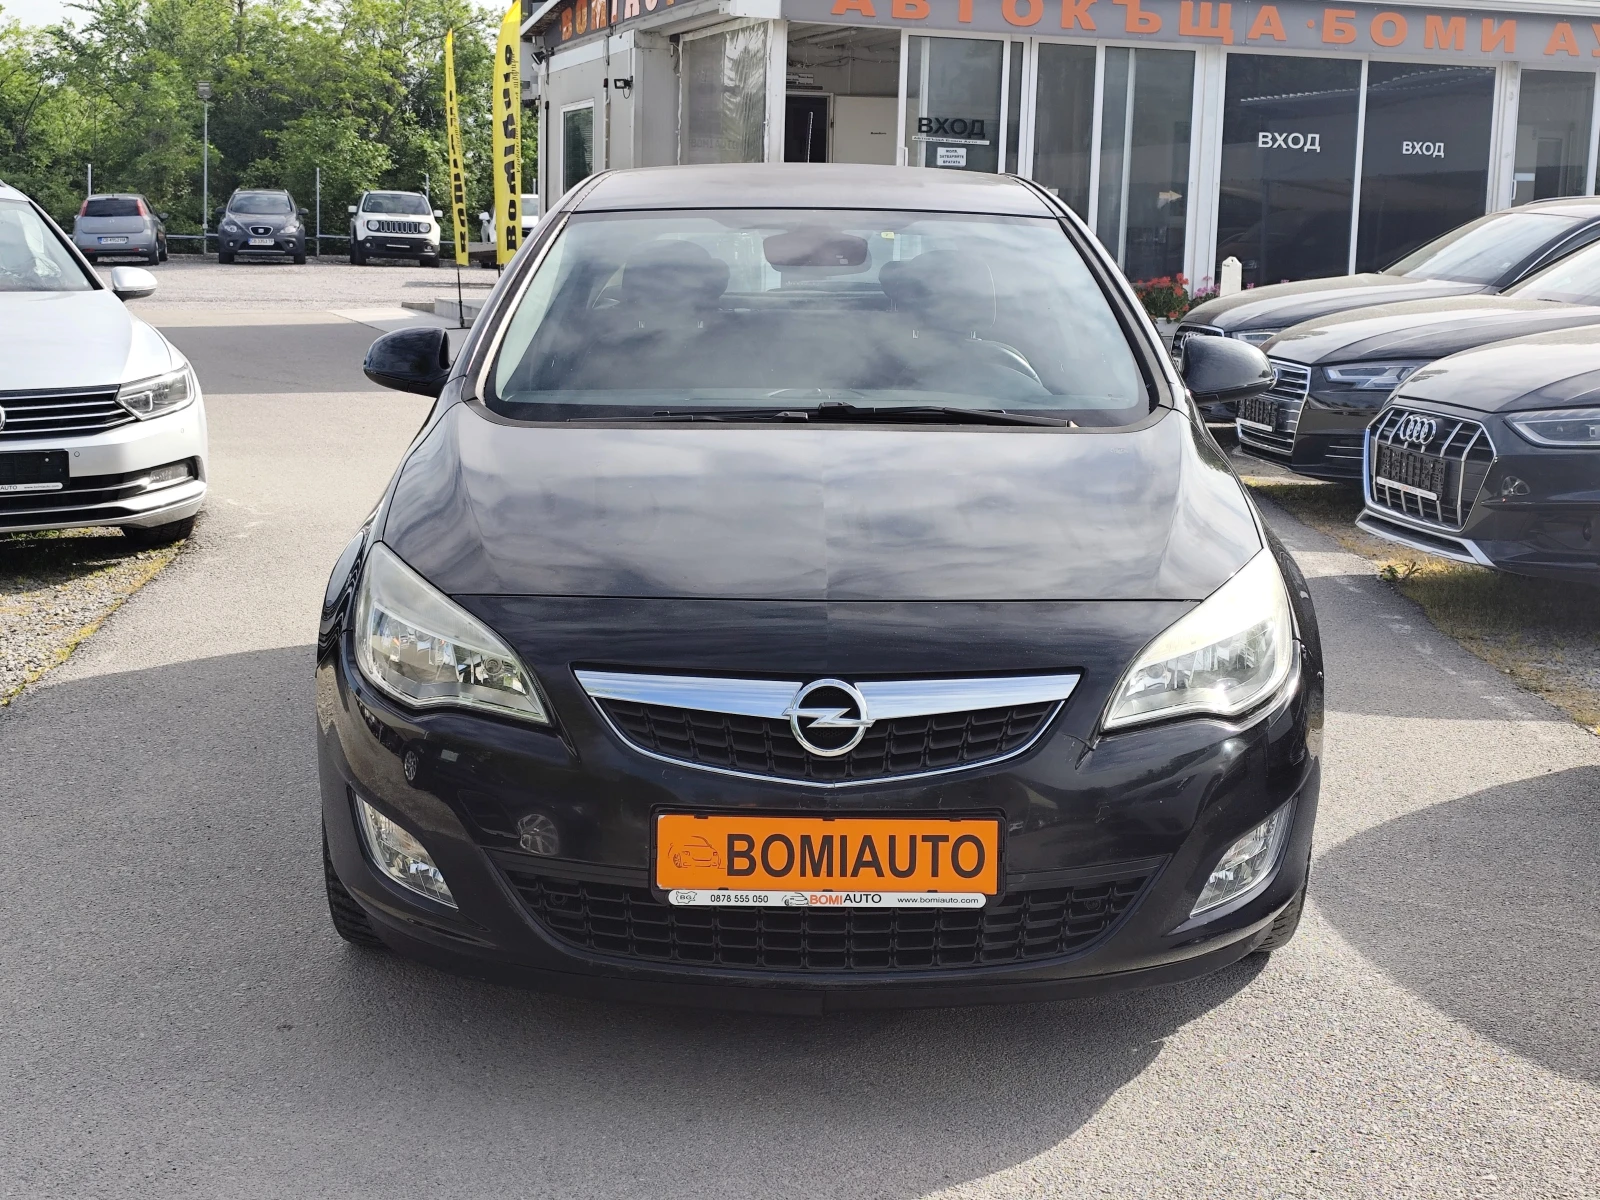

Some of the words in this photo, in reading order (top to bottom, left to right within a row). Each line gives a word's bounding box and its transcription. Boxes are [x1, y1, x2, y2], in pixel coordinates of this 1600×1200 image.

[1321, 8, 1517, 53] БОМИ
[1543, 22, 1600, 57] А
[918, 117, 985, 139] ВХОД
[1258, 132, 1321, 152] ВХОД
[1402, 141, 1445, 158] ВХОД
[726, 833, 986, 879] BOMIAUTO
[710, 894, 732, 903] 0878
[734, 894, 750, 903] 555
[752, 894, 769, 903] 050
[897, 896, 979, 904] www.bomiauto.com
